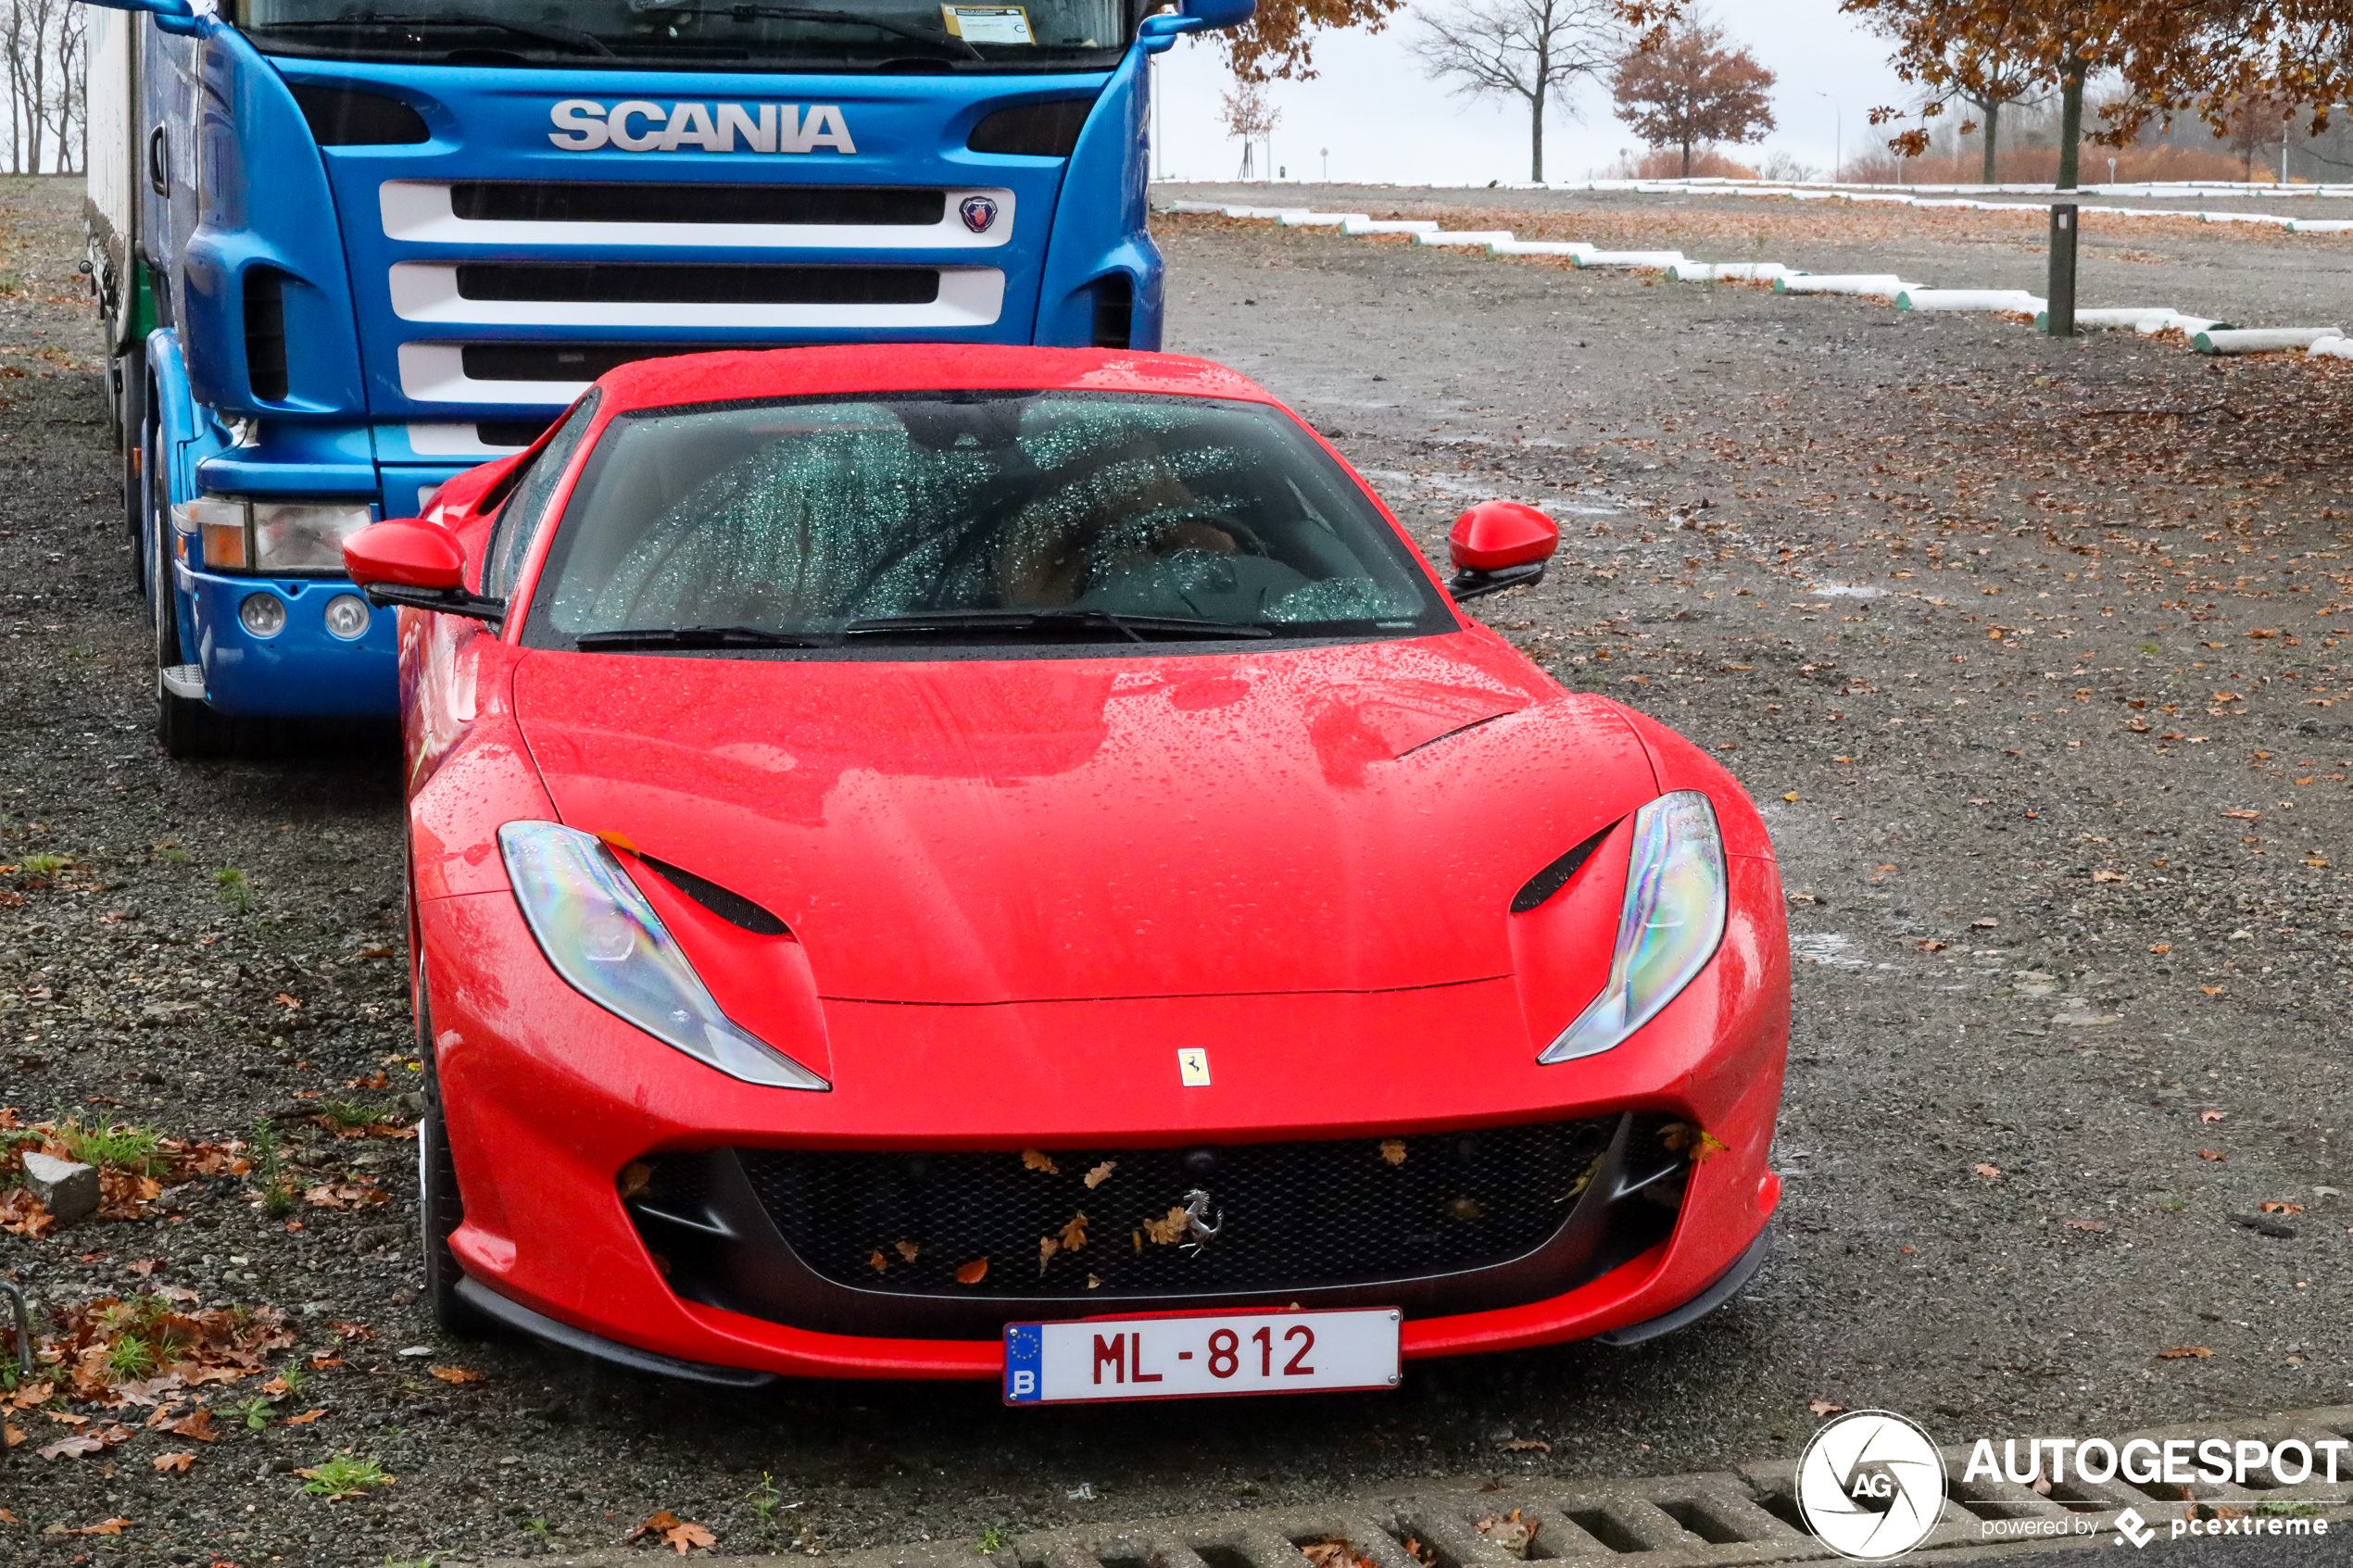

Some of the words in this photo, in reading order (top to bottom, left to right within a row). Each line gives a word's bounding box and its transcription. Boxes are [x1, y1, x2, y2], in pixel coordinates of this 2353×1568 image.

[1014, 24, 1026, 33] C
[548, 99, 857, 154] SCANIA
[1093, 1325, 1315, 1385] ML-812
[1013, 1371, 1035, 1394] B
